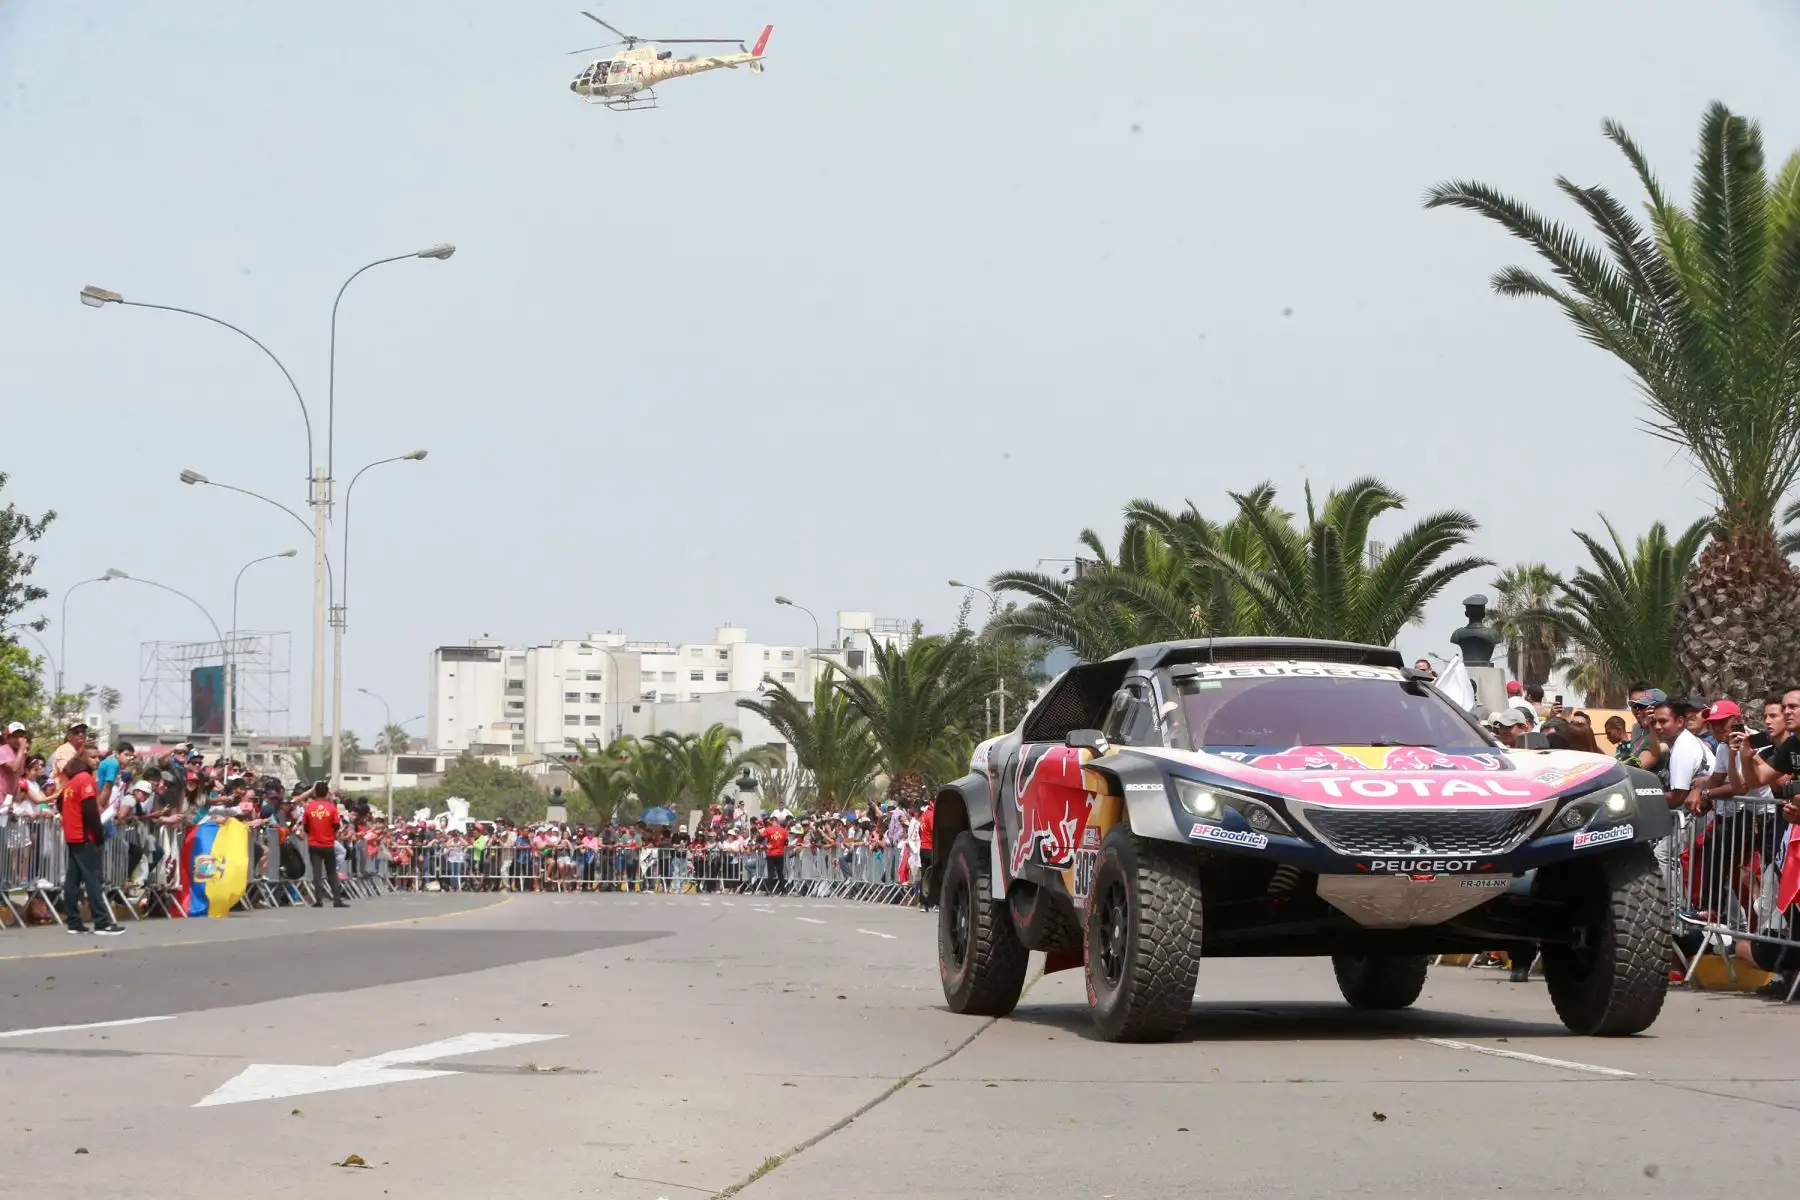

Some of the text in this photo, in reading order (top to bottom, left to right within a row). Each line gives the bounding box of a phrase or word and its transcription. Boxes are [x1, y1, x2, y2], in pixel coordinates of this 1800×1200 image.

[1125, 783, 1164, 792] sparco
[1301, 776, 1532, 797] TOTAL
[1192, 824, 1268, 846] BFGoodrich
[1574, 824, 1634, 846] BFGoodrich
[1371, 860, 1477, 871] PEUGEOT
